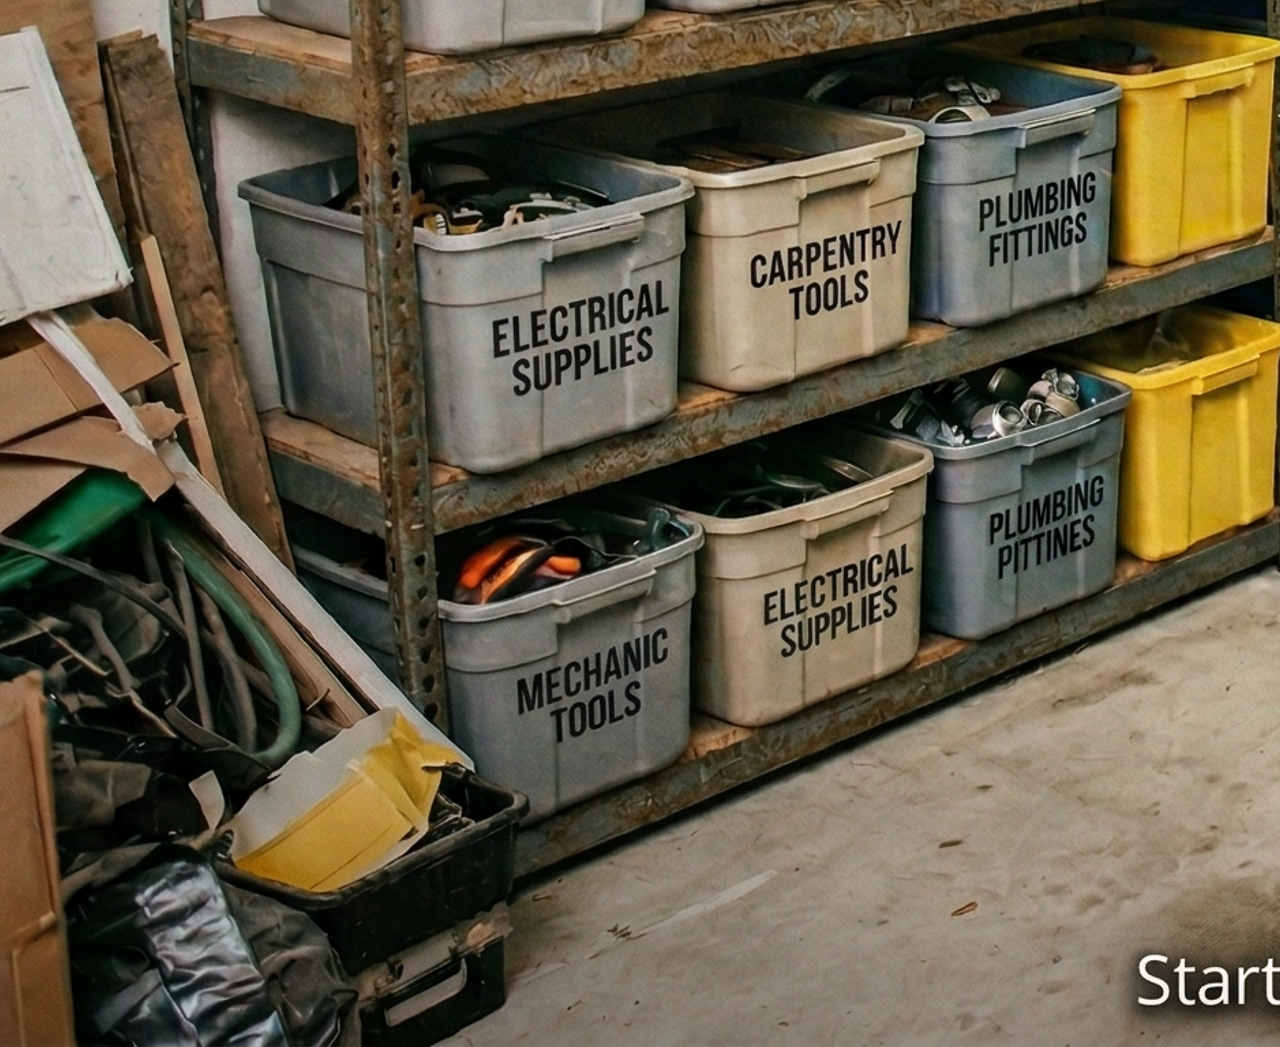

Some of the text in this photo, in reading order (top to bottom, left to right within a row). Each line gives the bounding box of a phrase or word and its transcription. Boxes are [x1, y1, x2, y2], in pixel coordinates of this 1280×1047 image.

[979, 171, 1097, 233] PLUMBING
[750, 220, 902, 289] CARPENTRY
[988, 211, 1088, 267] FITTINGS
[491, 280, 669, 358] ELECTRICAL
[788, 269, 869, 320] TOOLS
[512, 326, 654, 397] SUPPLIES
[989, 475, 1104, 547] PLUMBING
[997, 514, 1096, 580] PITTINES
[763, 543, 914, 627] ELECTRICAL
[780, 584, 898, 659] SUPPLIES
[517, 627, 669, 716] MECHANIC
[550, 680, 641, 744] TOOLS
